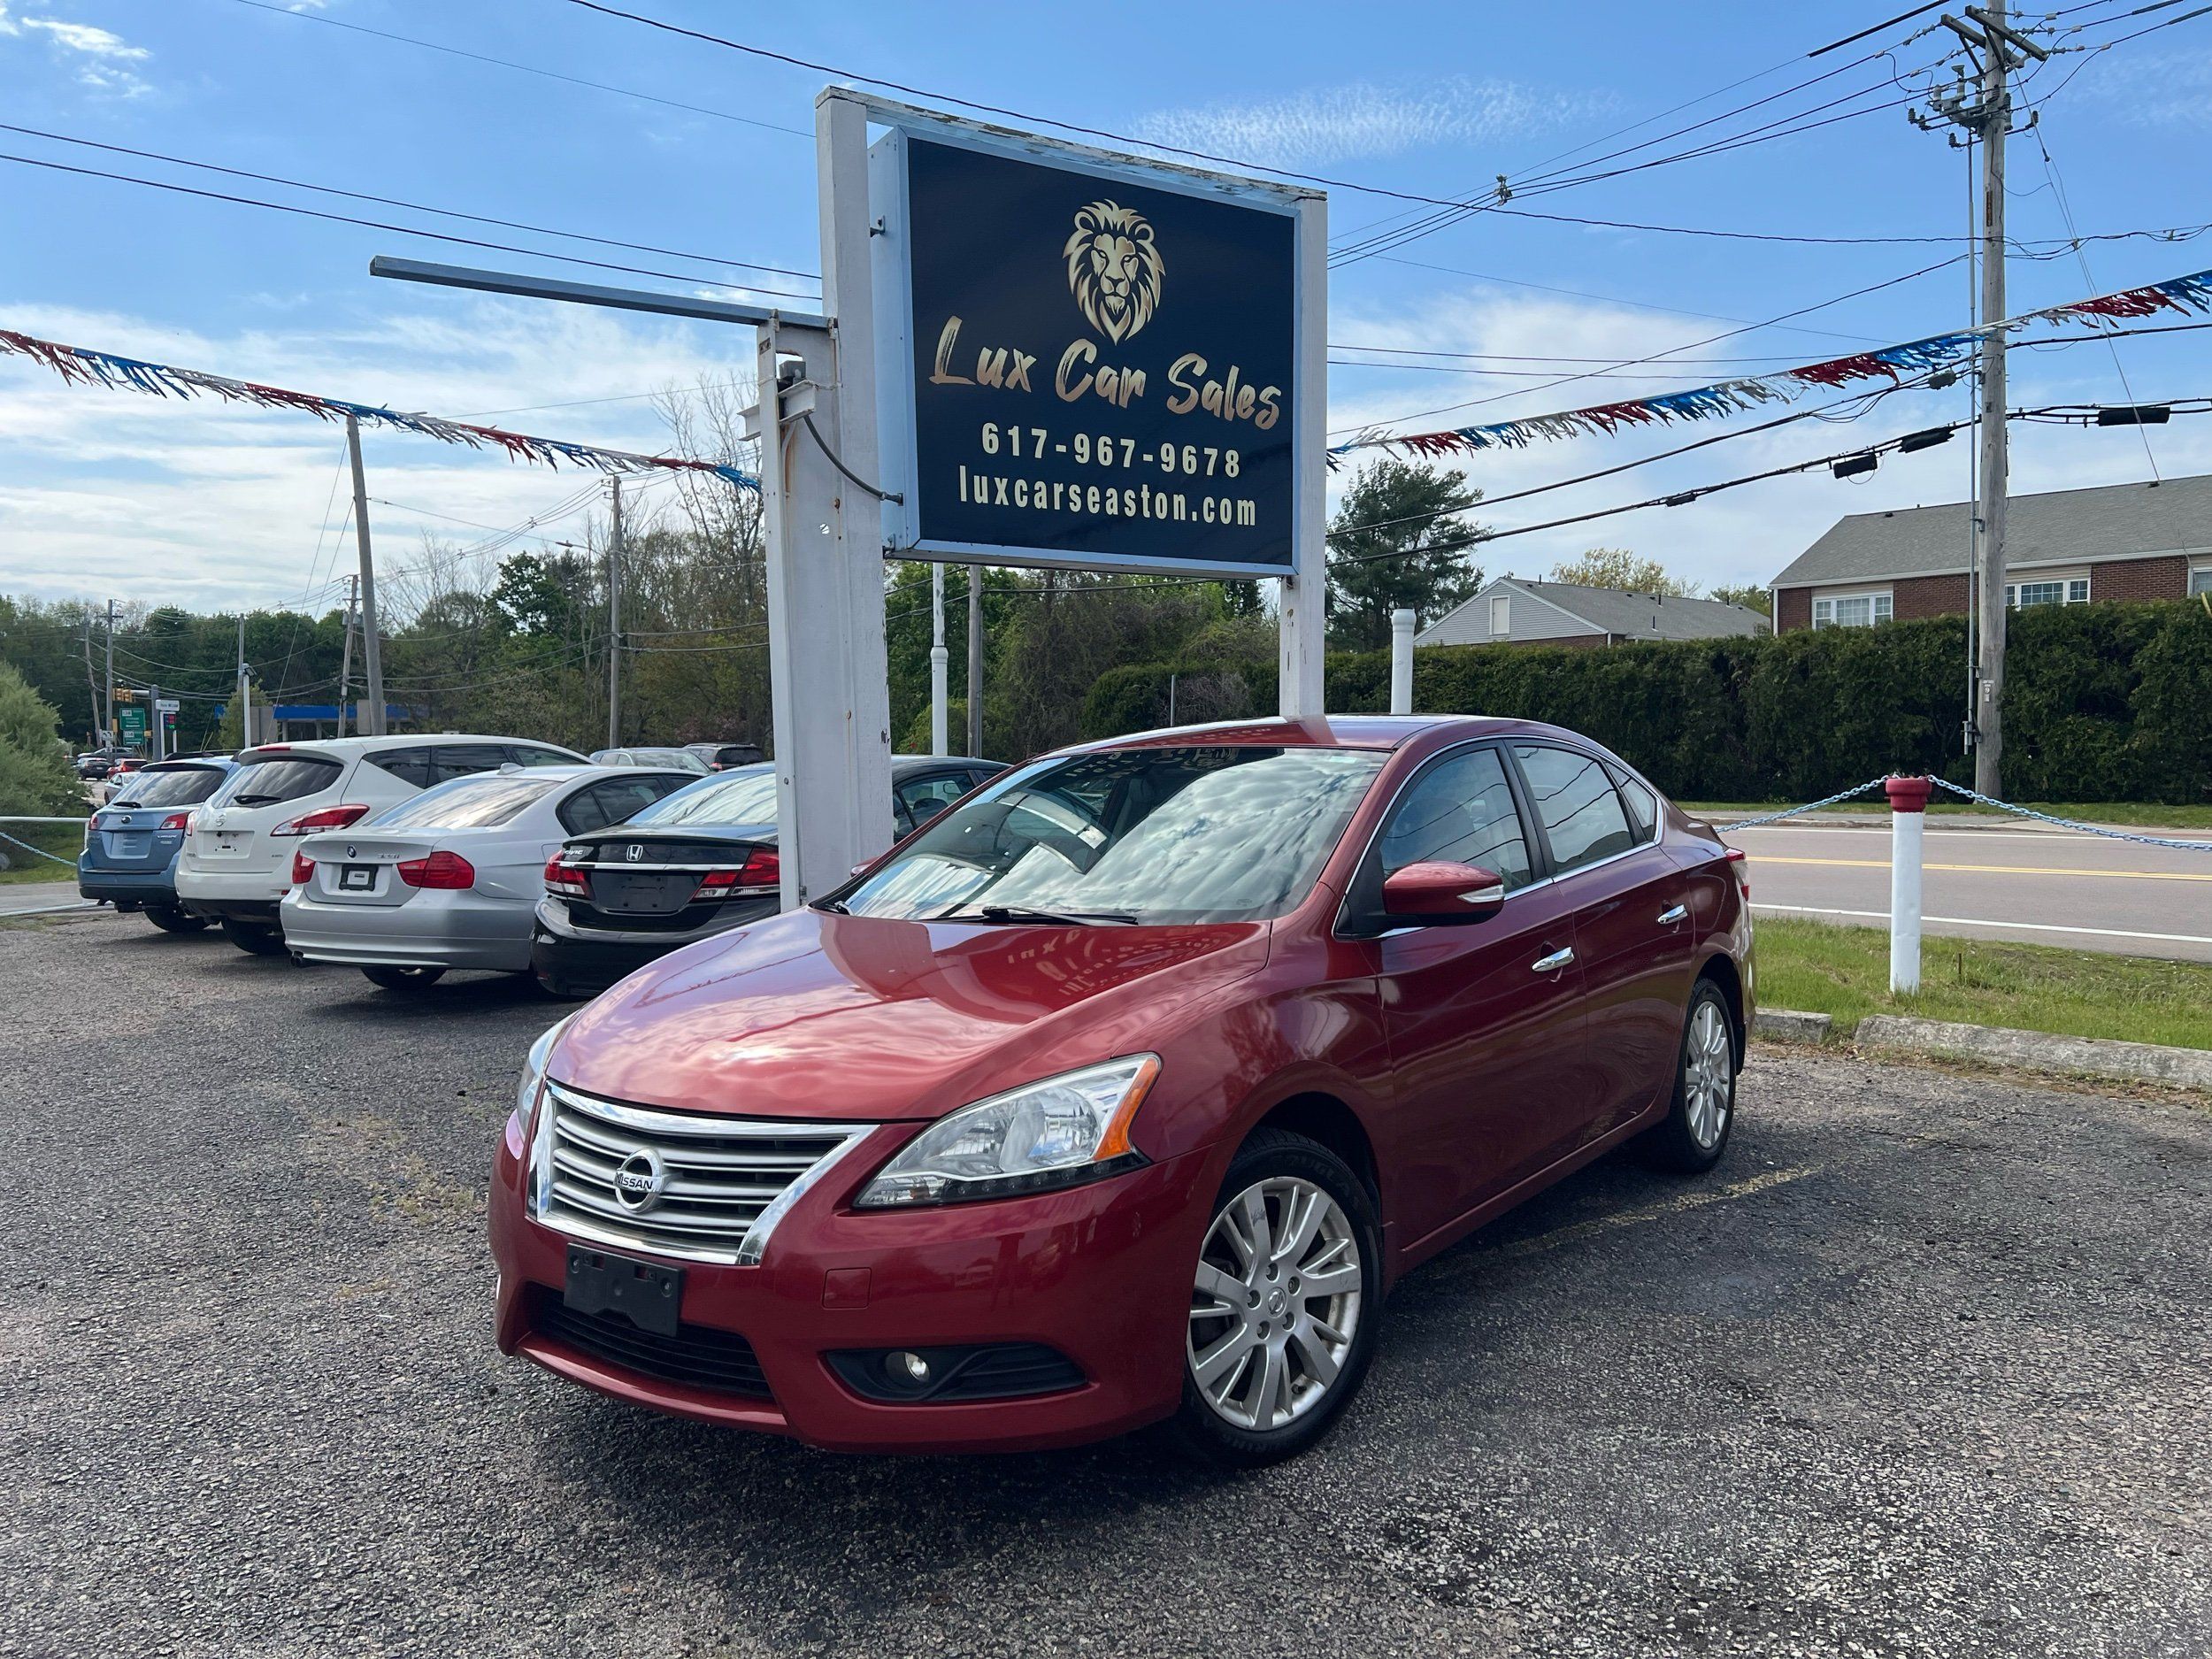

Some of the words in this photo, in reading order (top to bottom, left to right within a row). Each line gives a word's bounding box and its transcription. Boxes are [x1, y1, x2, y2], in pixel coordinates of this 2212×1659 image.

[929, 316, 1037, 392] Lux
[1056, 339, 1147, 409] Car
[1166, 353, 1282, 429] Sales
[981, 422, 1240, 478] 617-967-9678
[959, 465, 1256, 526] luxcarseaston.com
[618, 1174, 653, 1189] NISSAN
